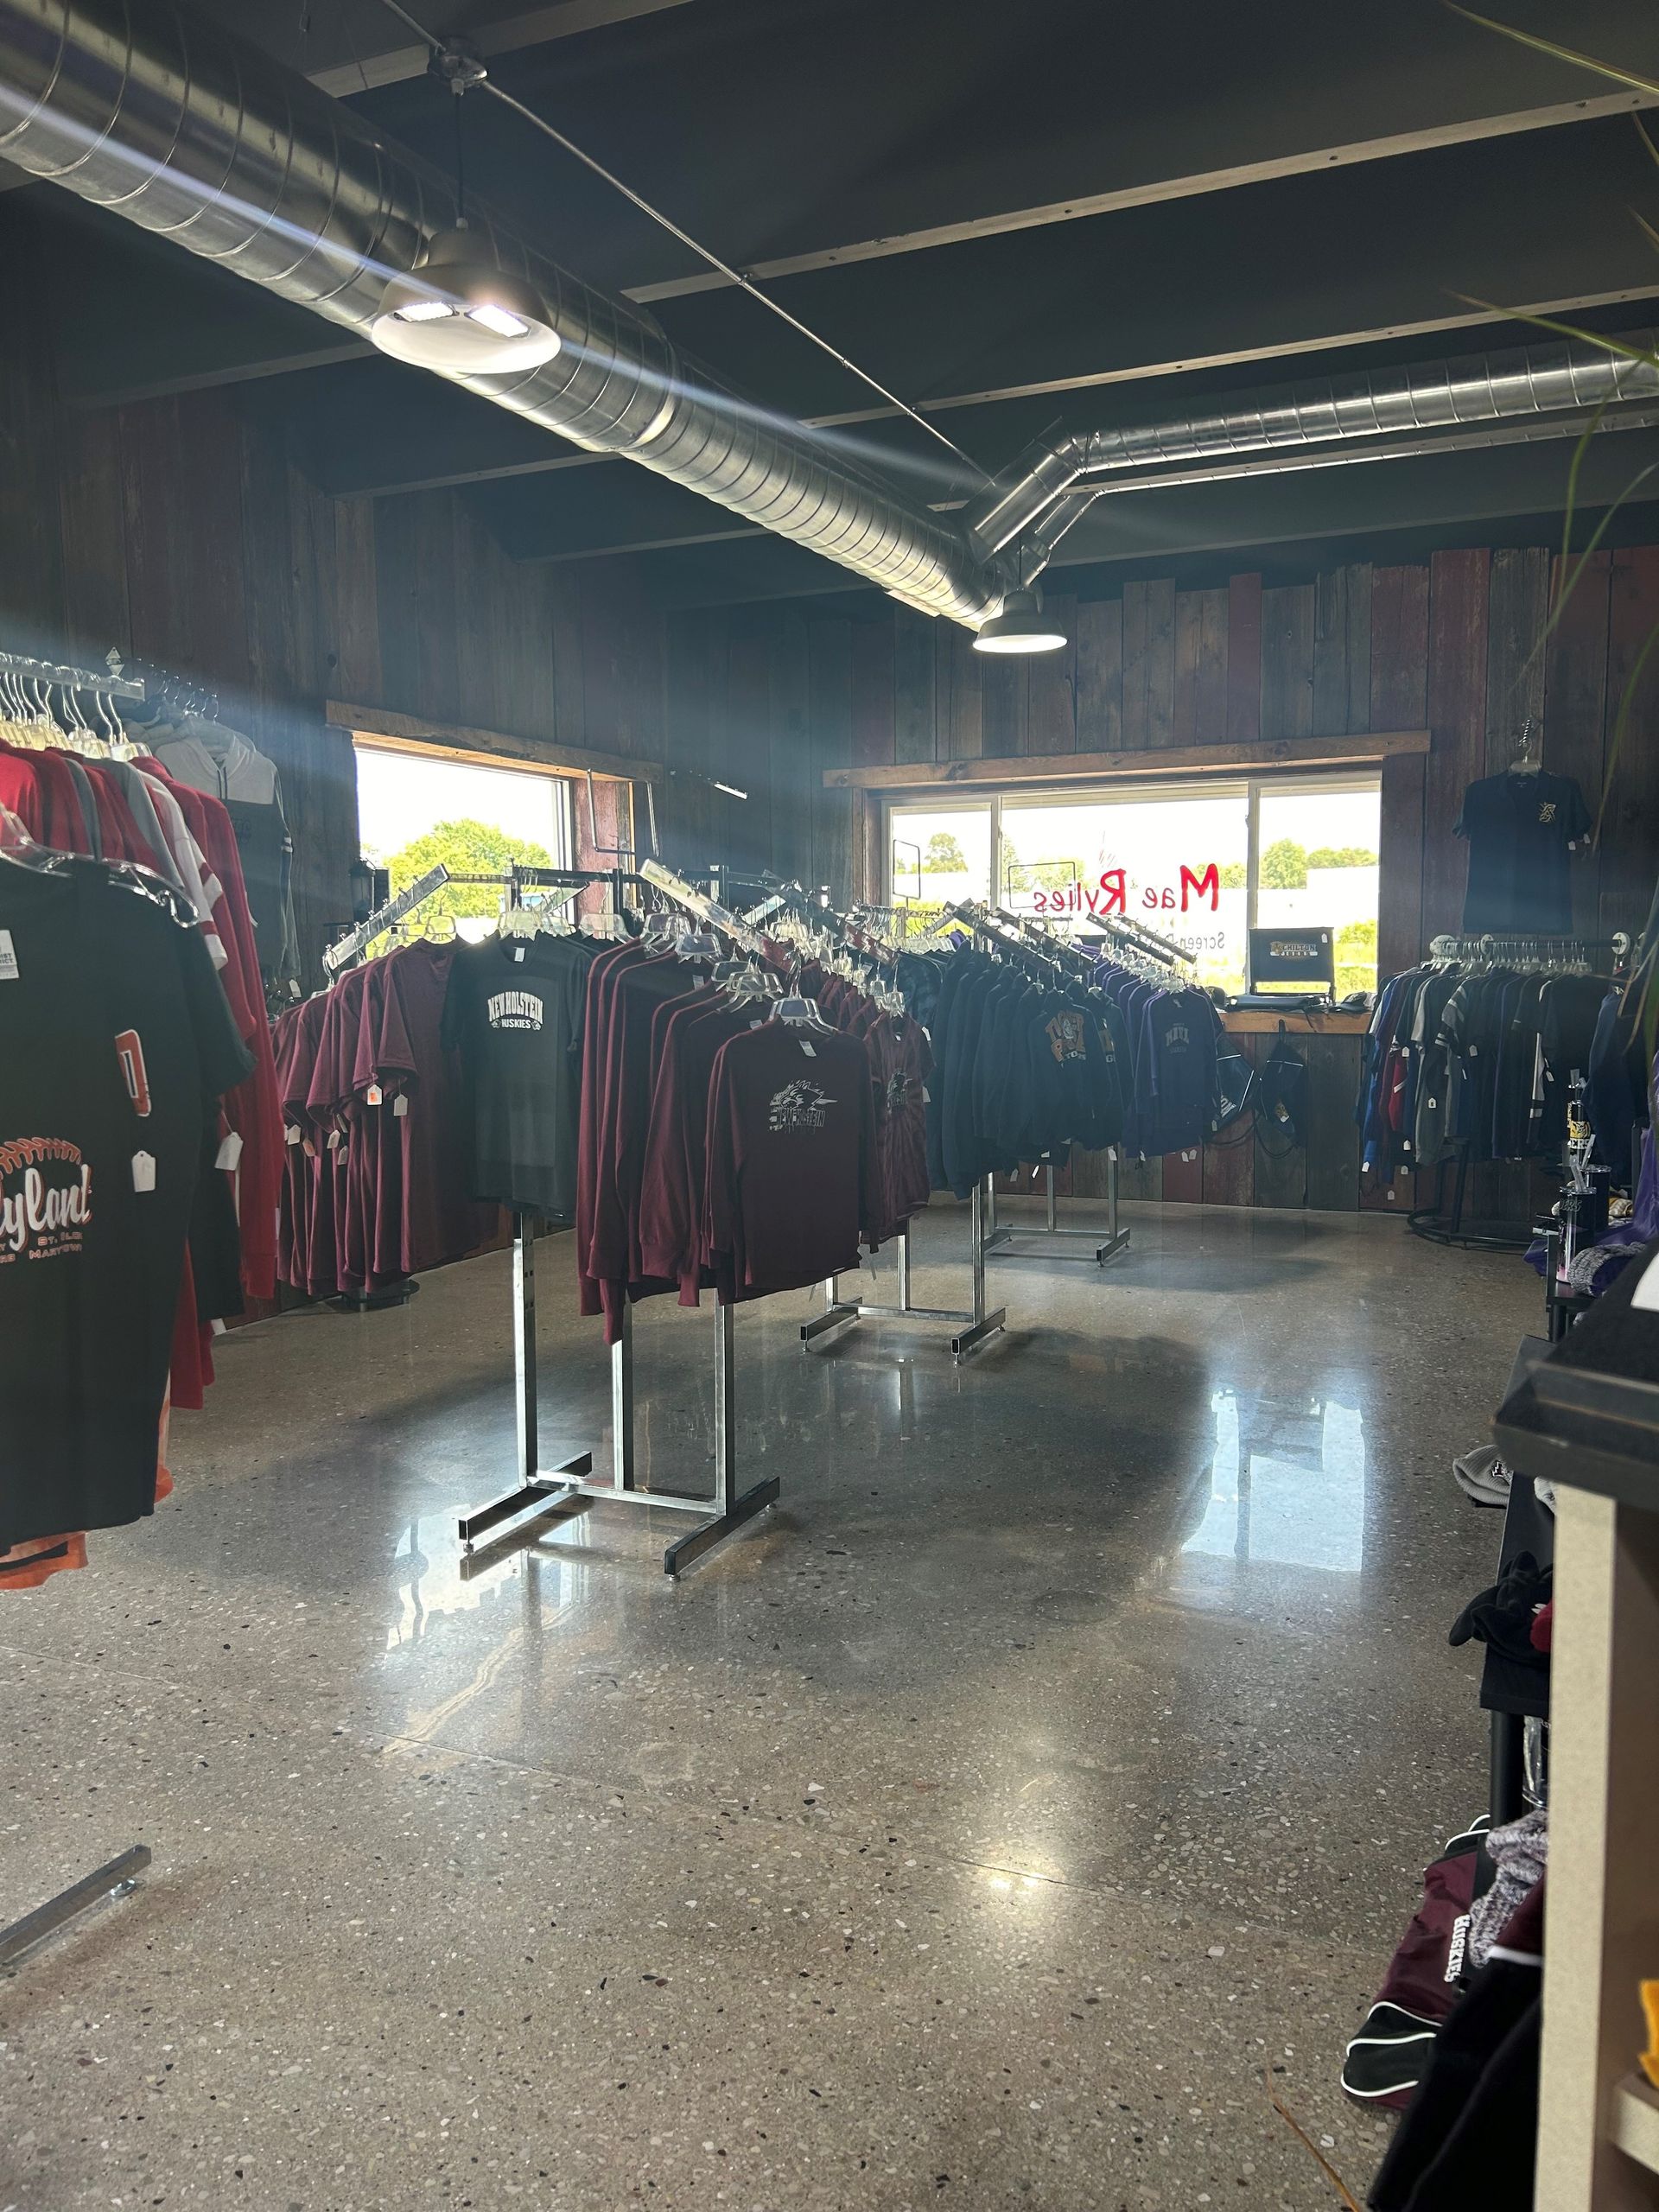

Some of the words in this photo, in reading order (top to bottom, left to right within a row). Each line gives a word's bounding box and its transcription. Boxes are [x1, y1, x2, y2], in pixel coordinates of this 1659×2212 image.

[488, 992, 505, 1021] NEW
[505, 991, 543, 1025] HOLSTEIN
[501, 1019, 531, 1029] HUSKIES
[1444, 1915, 1471, 1982] HUSKIES
